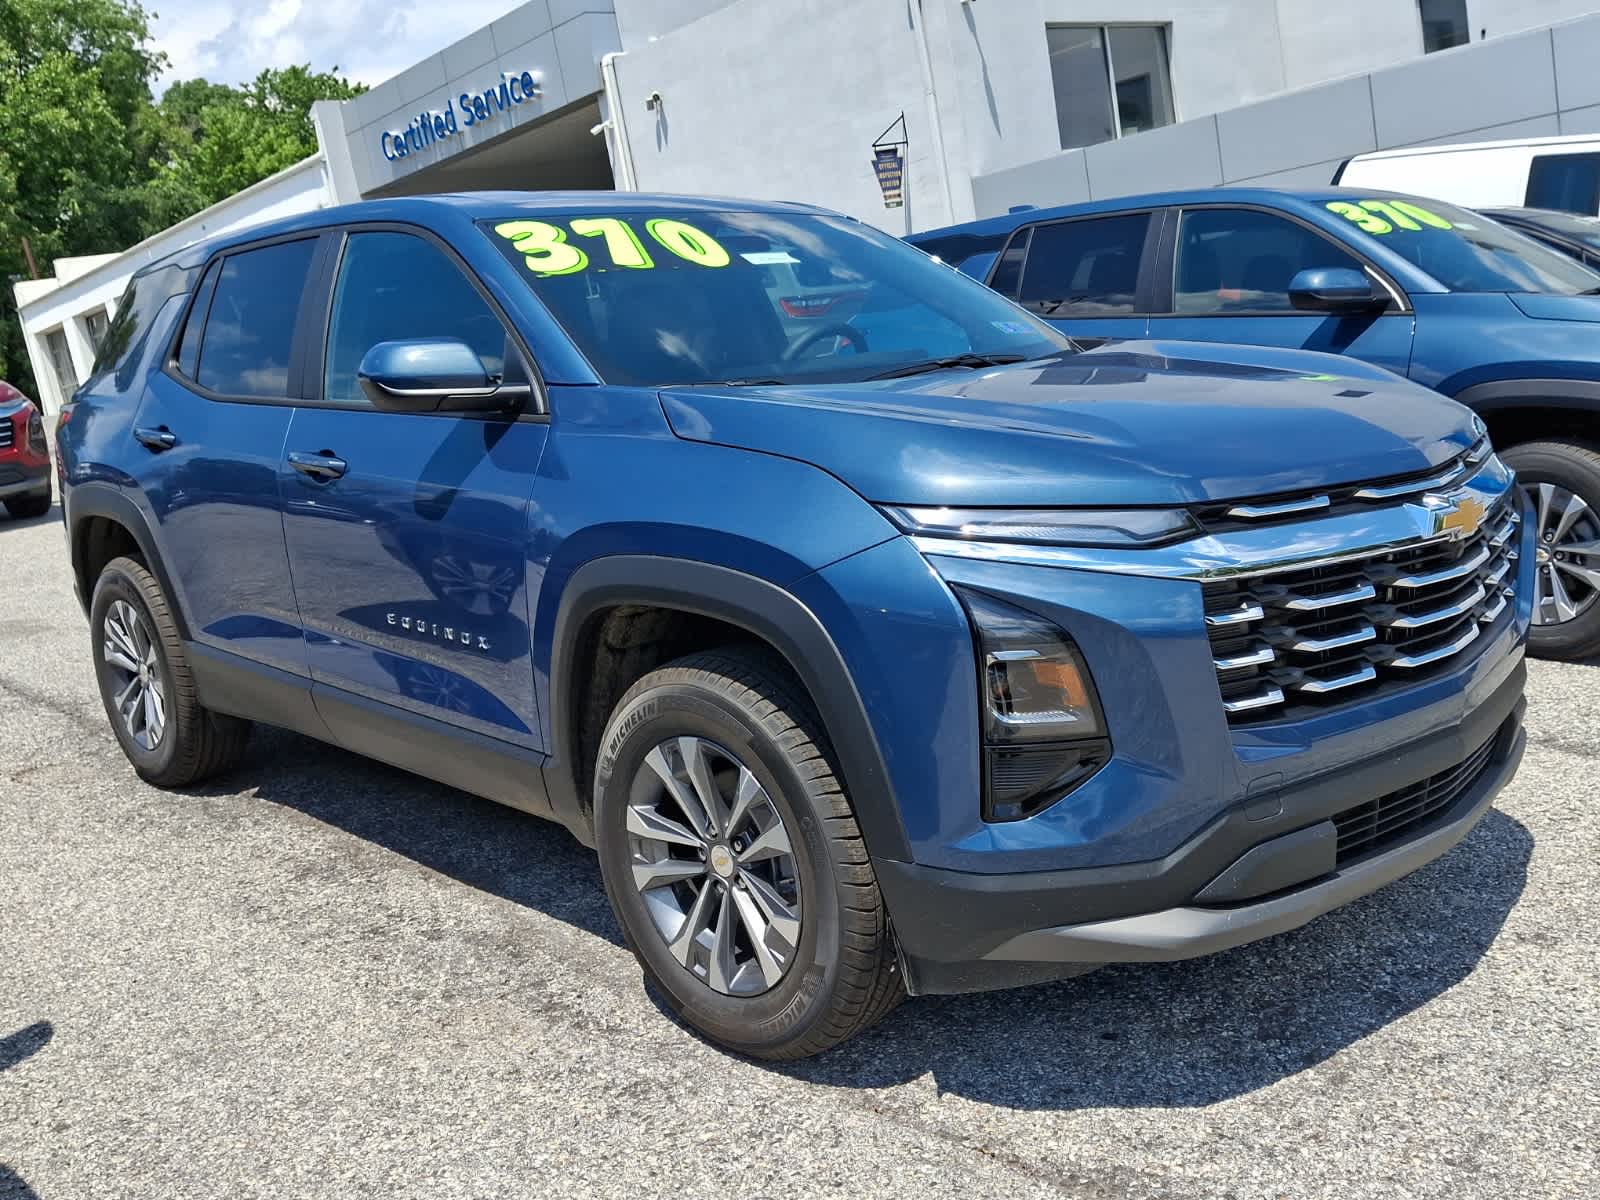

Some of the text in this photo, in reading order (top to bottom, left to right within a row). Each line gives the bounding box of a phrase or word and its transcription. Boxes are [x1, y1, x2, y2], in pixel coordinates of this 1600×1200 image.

[381, 71, 535, 161] Certified Service
[1325, 200, 1452, 235] 370
[494, 217, 731, 276] 370
[386, 613, 490, 649] EQUINOX
[609, 701, 656, 755] MICHELIN
